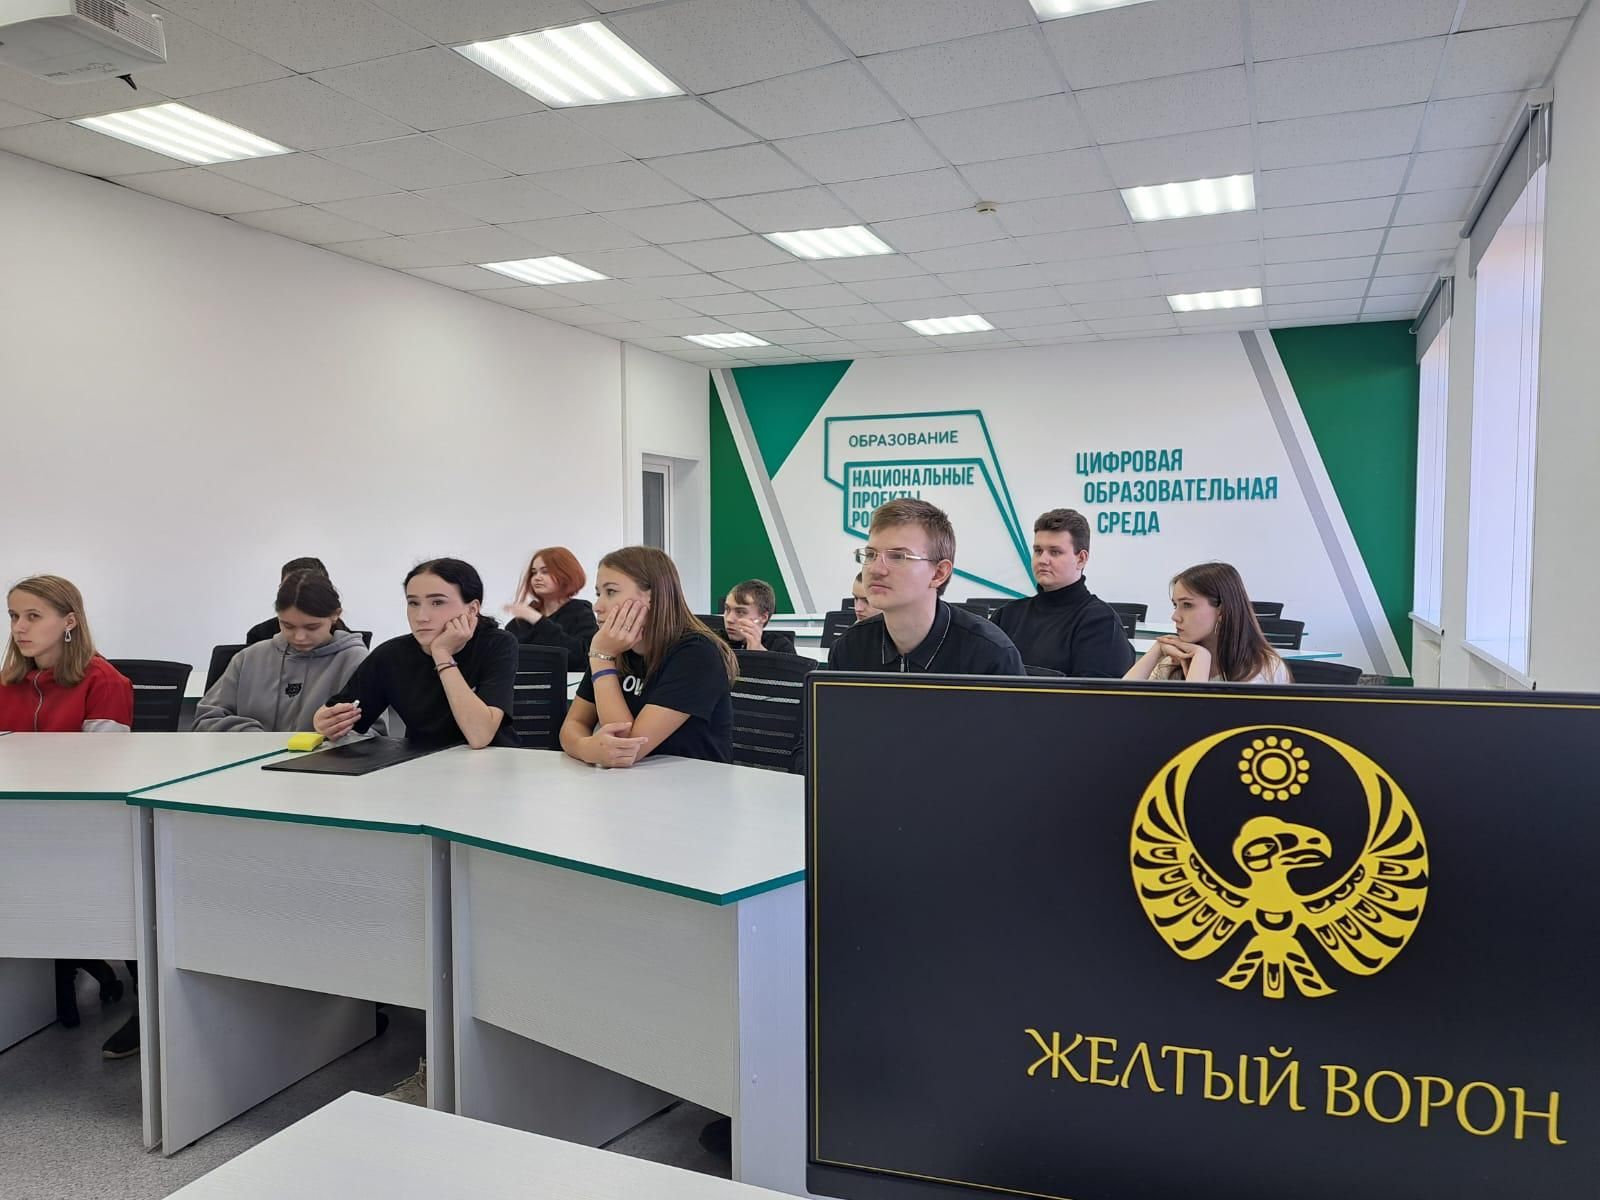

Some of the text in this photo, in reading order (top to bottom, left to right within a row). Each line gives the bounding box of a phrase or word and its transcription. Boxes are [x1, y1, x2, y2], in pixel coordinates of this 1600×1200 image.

[848, 430, 958, 447] ОБРАЗОВАНИЕ
[1076, 448, 1183, 476] ЦИФРОВАЯ
[852, 467, 975, 488] НАЦИОНАЛЬНЫЕ
[1084, 476, 1278, 504] ОБРАЗОВАТЕЛЬНАЯ
[1097, 511, 1160, 536] СРЕДА
[1024, 1028, 1567, 1145] ЖЕЛТЫЙ ВОРОН
